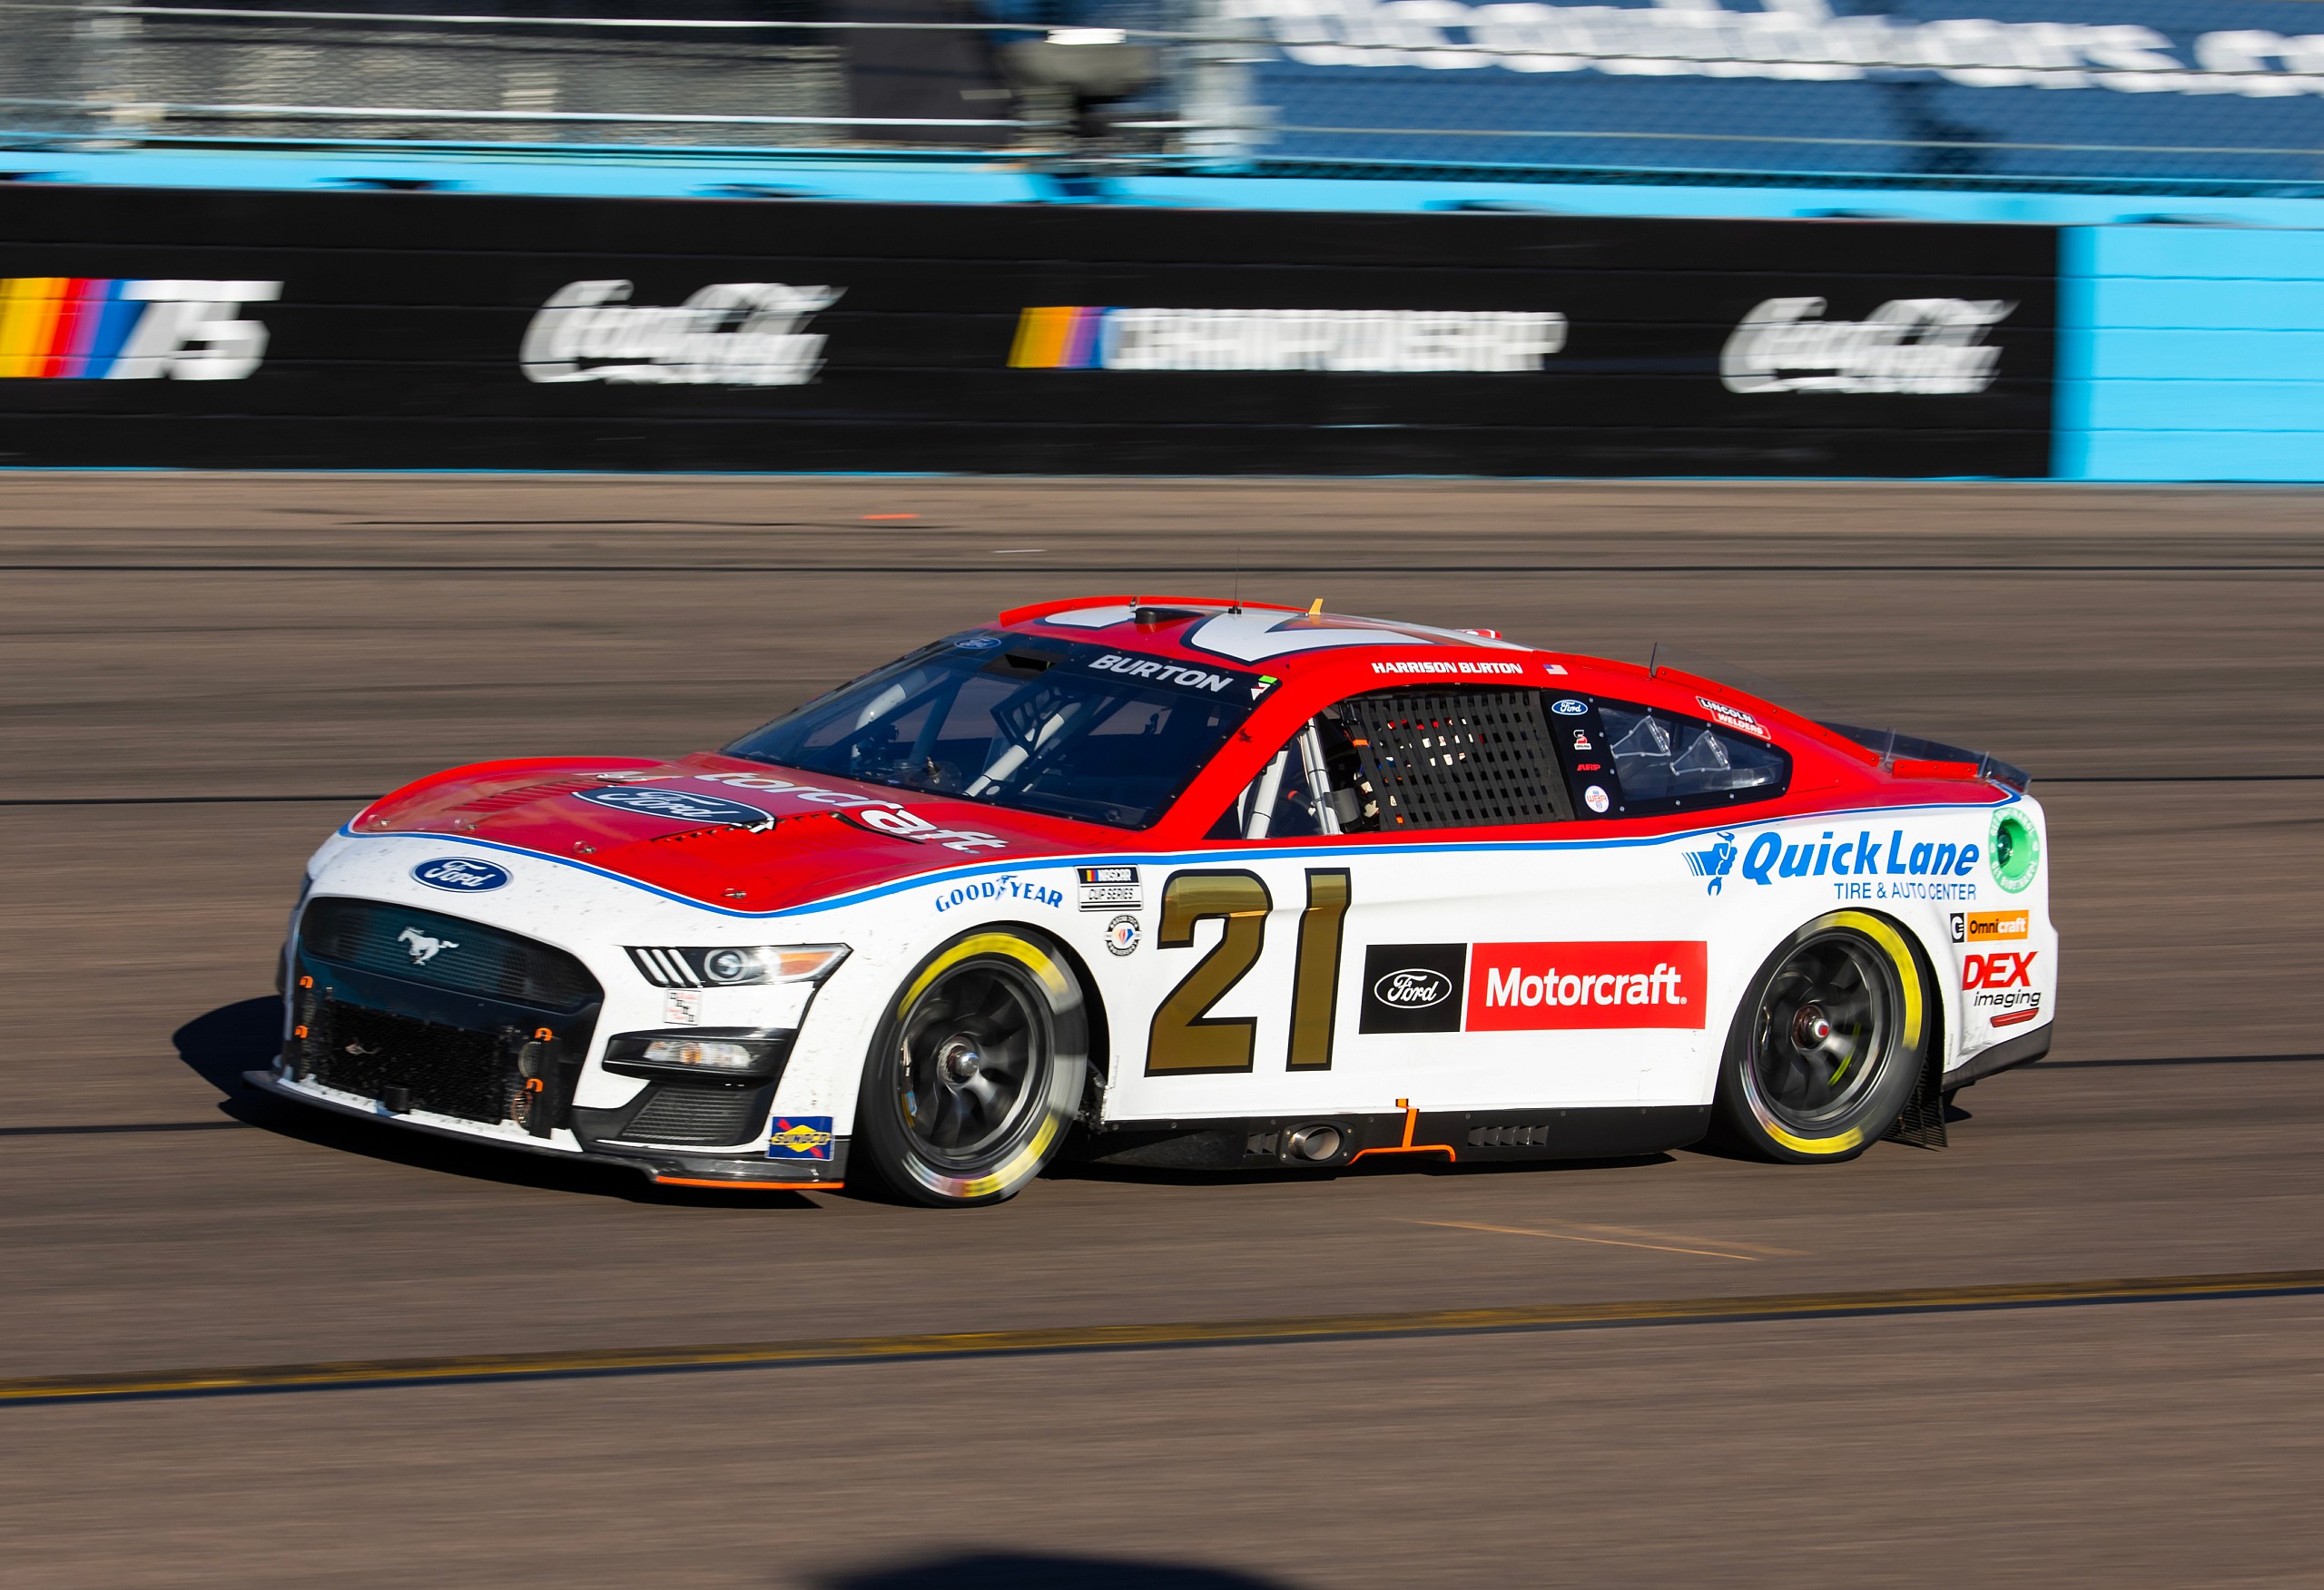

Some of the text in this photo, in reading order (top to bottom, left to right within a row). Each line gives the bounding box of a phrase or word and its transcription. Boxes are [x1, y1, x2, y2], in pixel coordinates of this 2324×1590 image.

[1089, 653, 1233, 692] BURTON
[1371, 662, 1523, 674] HARRISON BURTON
[1560, 702, 1582, 712] Ford
[1700, 698, 1754, 723] LINCOLN
[1718, 712, 1764, 735] WELDERS
[596, 791, 739, 818] Ford
[1742, 831, 1883, 886] Quick
[1886, 829, 1980, 877] Lane
[423, 860, 497, 887] Ford
[1834, 882, 1977, 901] TIRE & AUTO CENTER
[1969, 918, 2027, 935] Omnicraft
[1144, 868, 1351, 1077] 21
[1962, 951, 2039, 991] DEX
[1386, 973, 1438, 1005] Ford
[1485, 963, 1683, 1008] Motorcraft
[1974, 988, 2042, 1008] imaging
